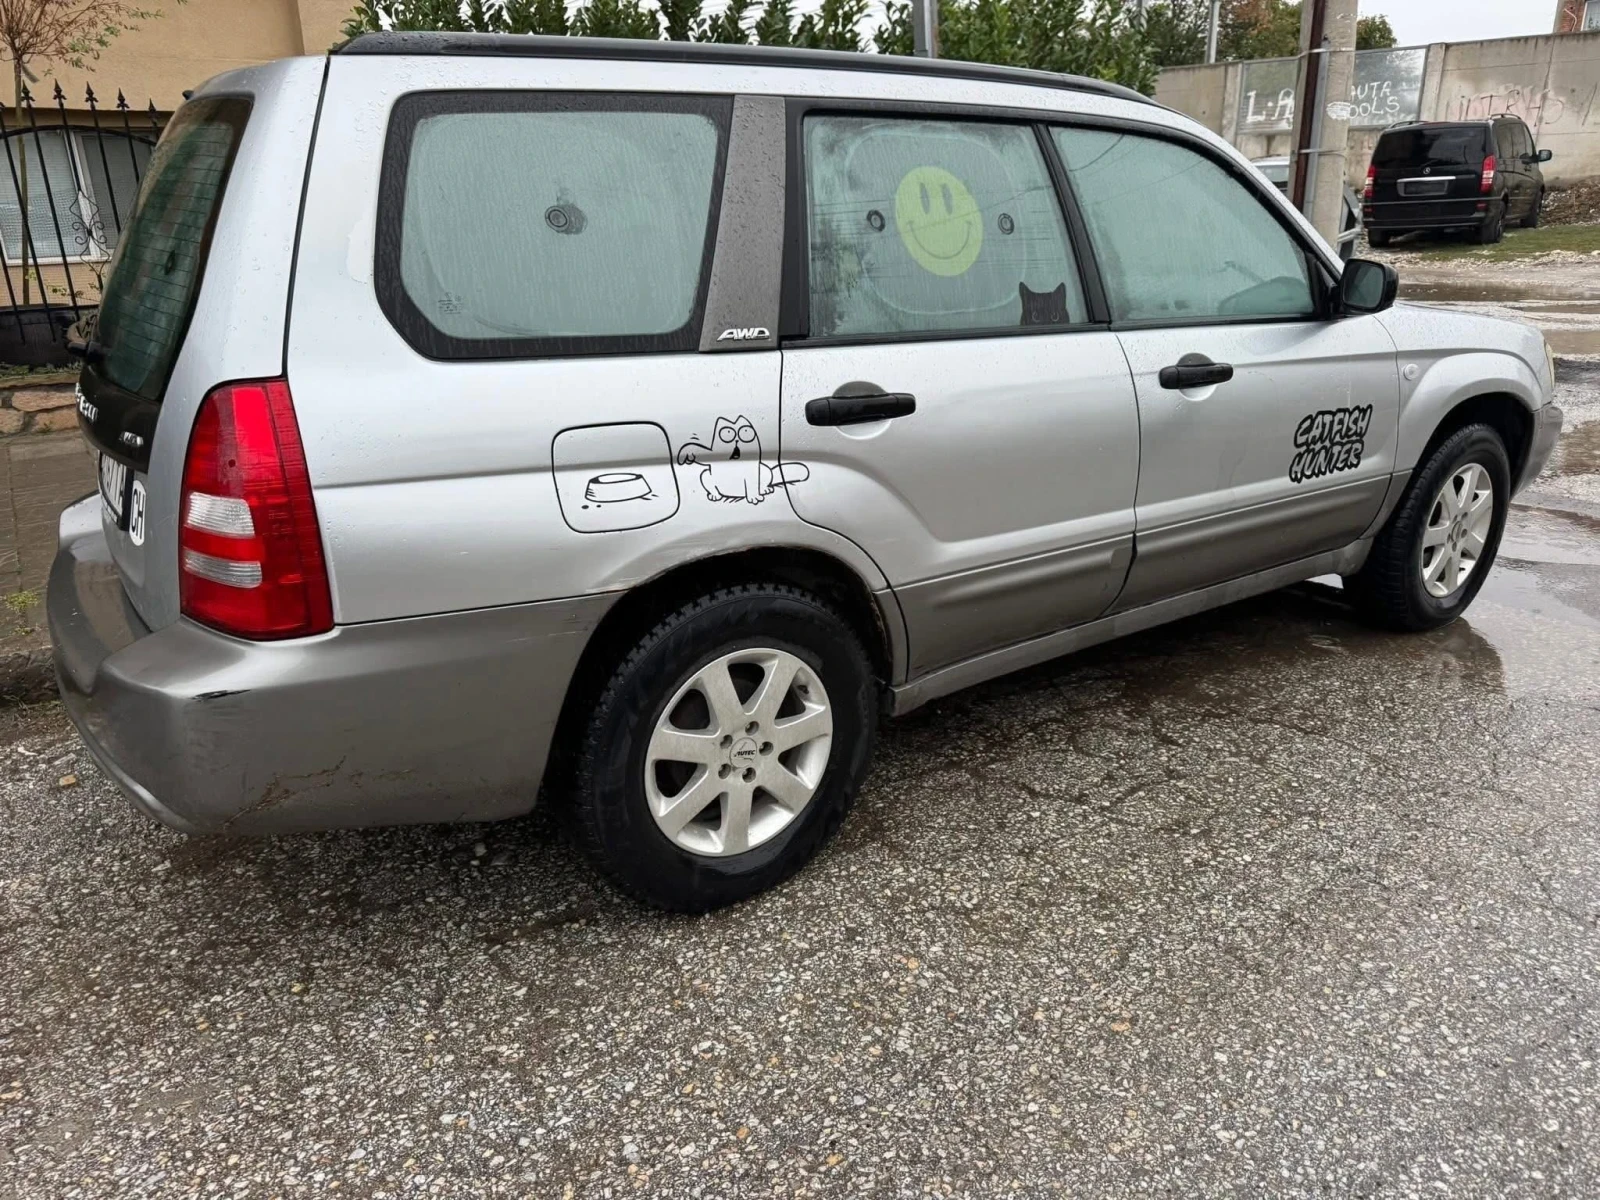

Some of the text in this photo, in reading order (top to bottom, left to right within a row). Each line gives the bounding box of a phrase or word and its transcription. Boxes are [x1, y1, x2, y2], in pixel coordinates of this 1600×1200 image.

[717, 327, 770, 341] AWD
[1294, 404, 1373, 448] CATFISH
[1289, 440, 1364, 484] HUNTER
[131, 488, 146, 541] CH
